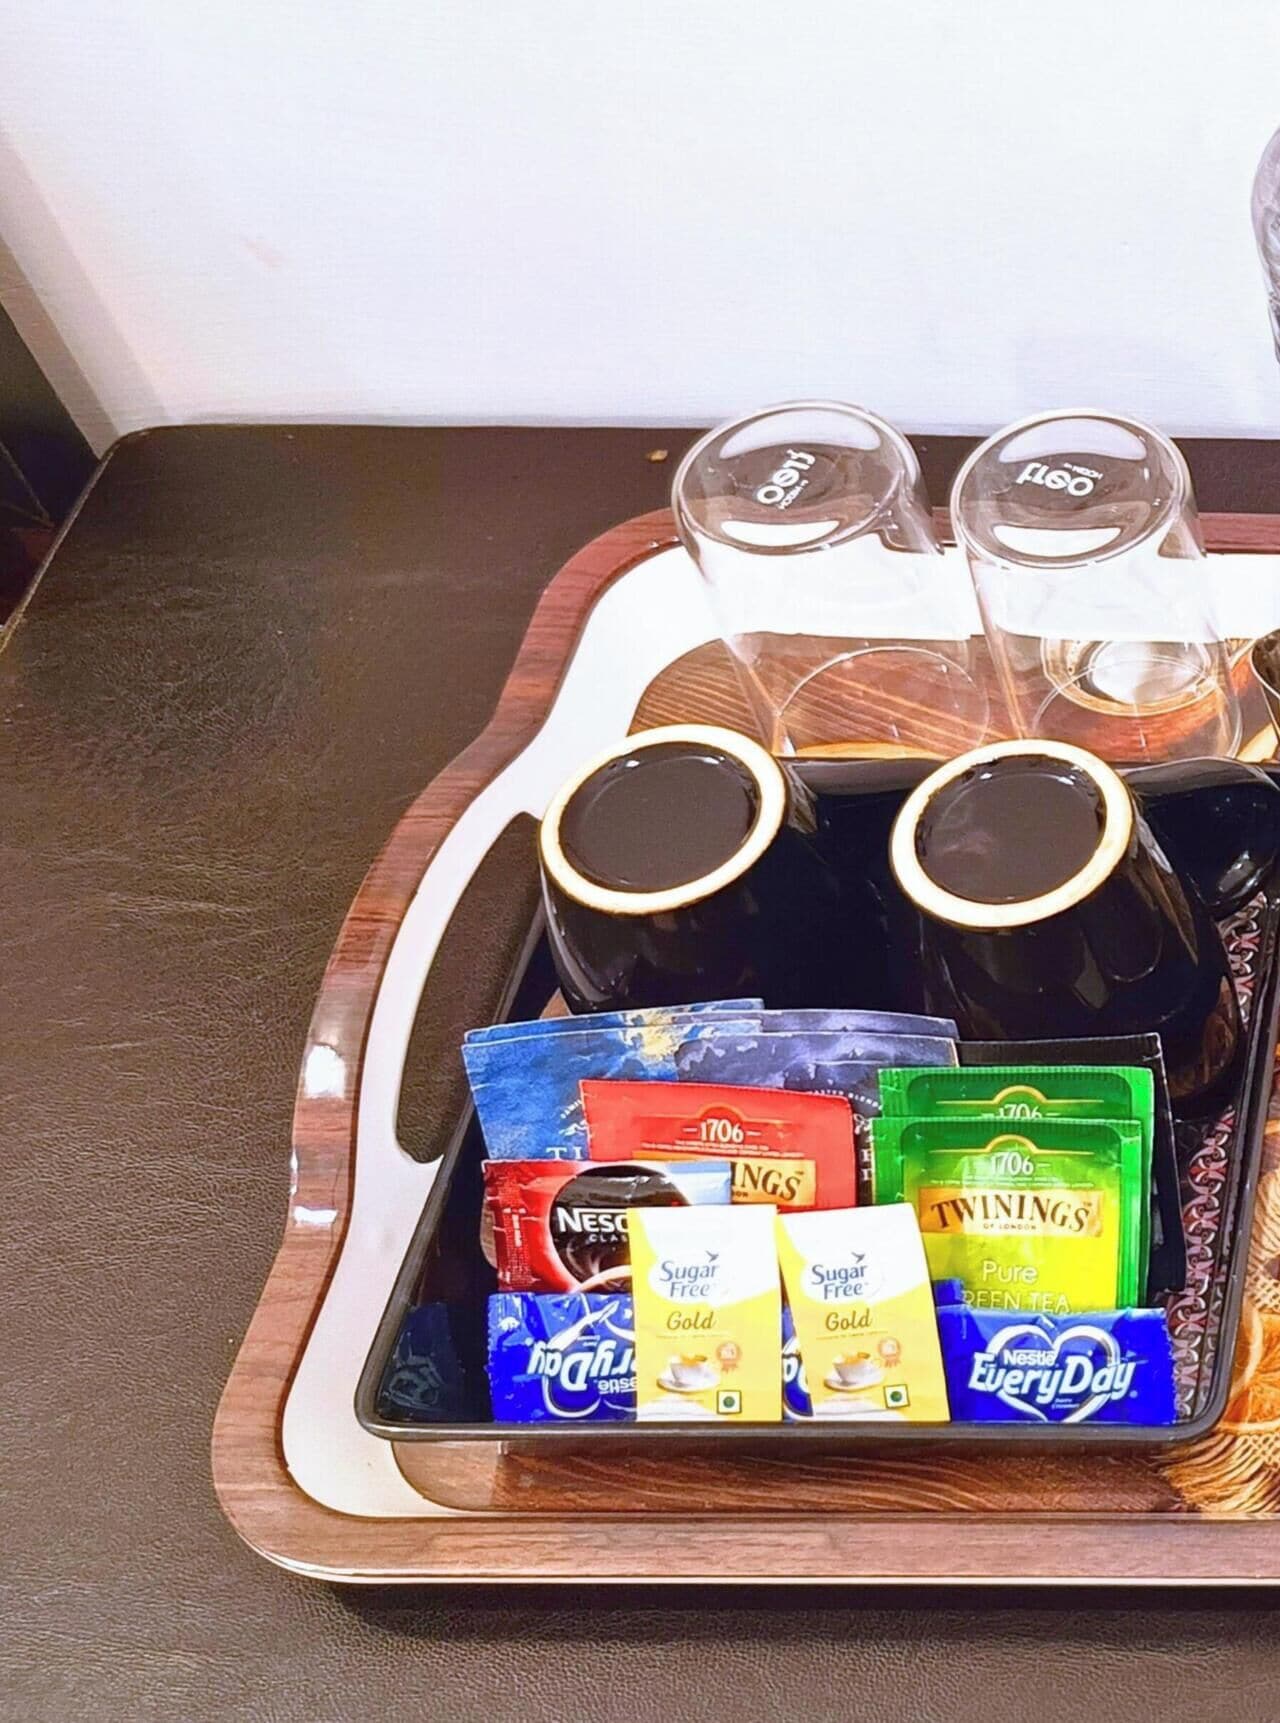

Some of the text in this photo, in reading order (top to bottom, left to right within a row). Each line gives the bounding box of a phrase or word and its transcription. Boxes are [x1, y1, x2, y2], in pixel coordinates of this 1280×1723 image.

[700, 1118, 744, 1143] 1706
[556, 1206, 629, 1234] NESC
[930, 1194, 1090, 1232] TWININGS
[659, 1260, 720, 1284] Sugar
[811, 1263, 867, 1285] Sugar
[983, 1259, 1038, 1284] Pure
[670, 1281, 710, 1298] Free
[824, 1282, 863, 1300] Free
[963, 1290, 1021, 1310] REEN
[667, 1310, 717, 1331] Gold
[825, 1308, 873, 1331] Gold
[968, 1351, 1136, 1404] EveryDay
